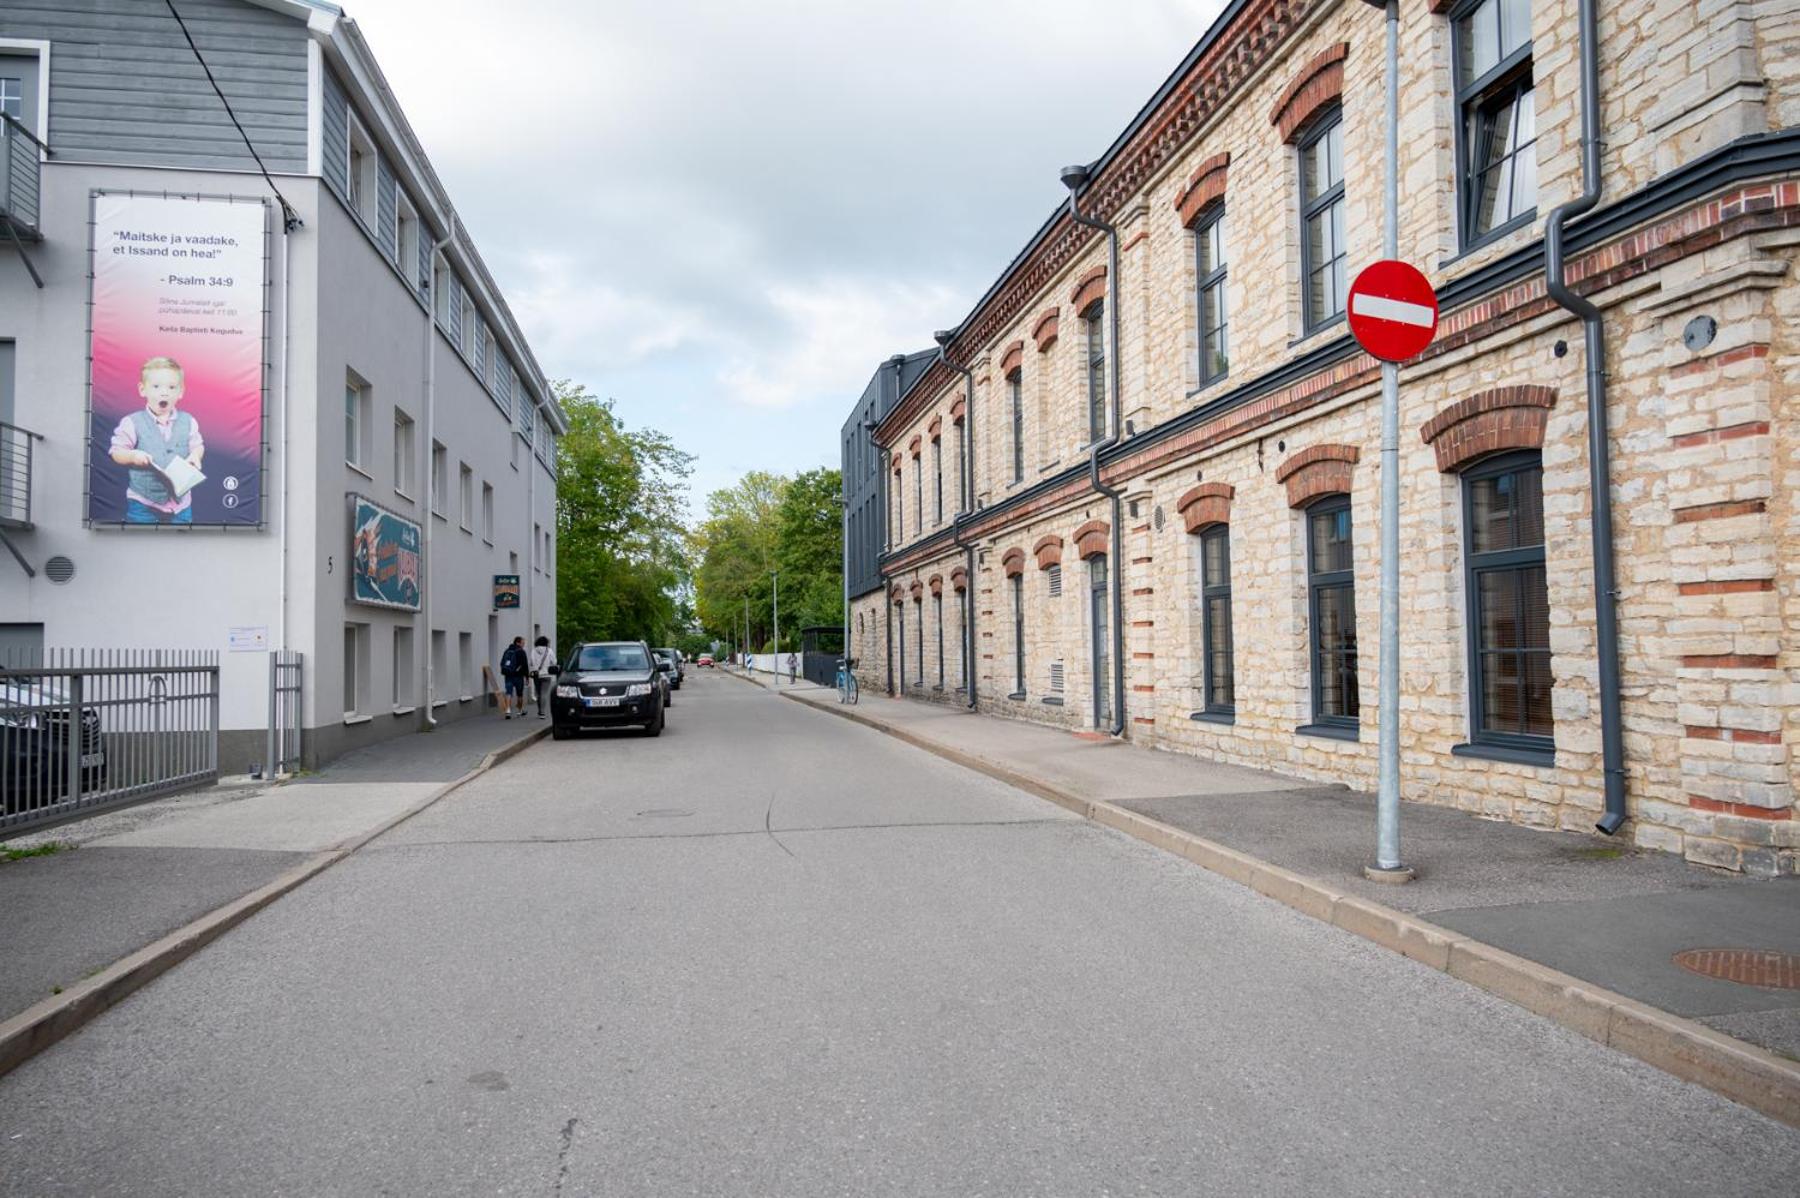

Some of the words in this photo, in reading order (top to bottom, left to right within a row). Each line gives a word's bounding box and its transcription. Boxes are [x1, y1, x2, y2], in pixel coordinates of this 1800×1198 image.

[113, 231, 167, 243] “Maitske
[170, 233, 182, 245] ja
[185, 235, 239, 247] vaadake,
[112, 246, 125, 255] et
[128, 246, 169, 257] Issand
[172, 249, 187, 258] on
[168, 275, 206, 286] Psalm
[208, 277, 234, 287] 34:9
